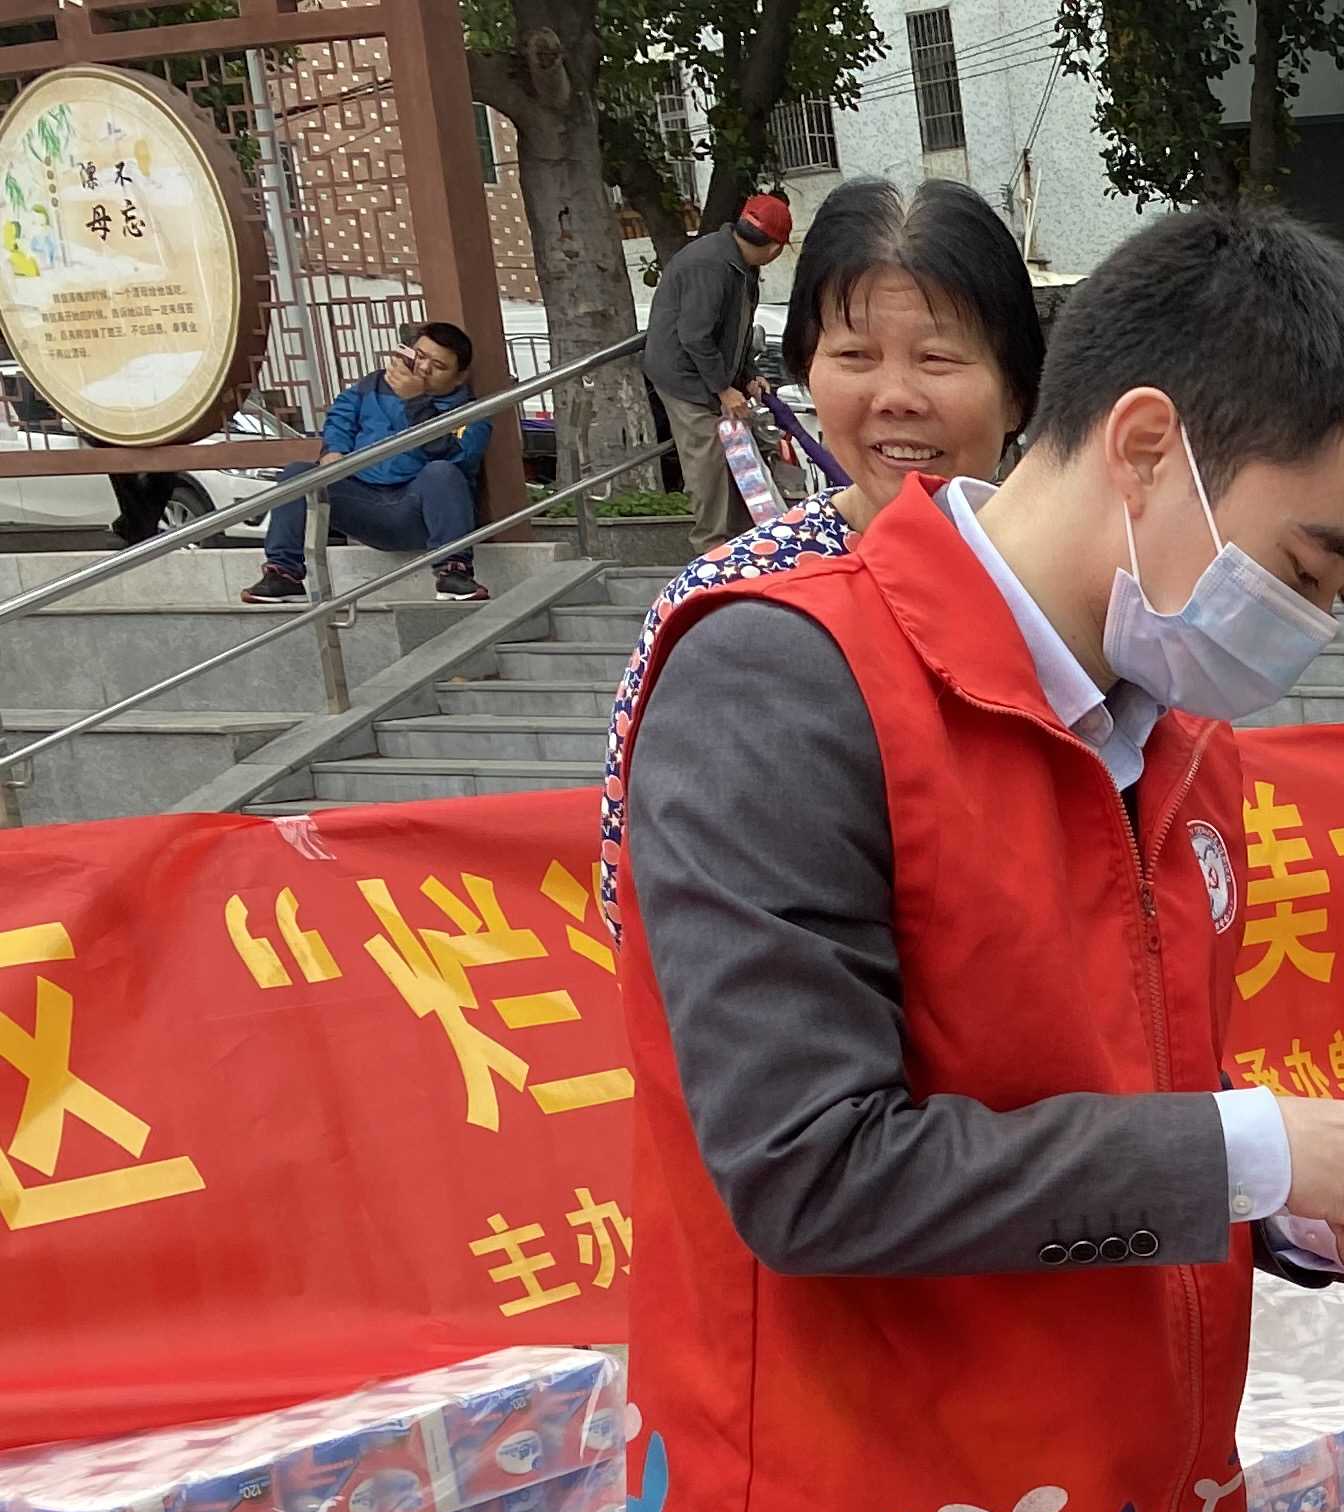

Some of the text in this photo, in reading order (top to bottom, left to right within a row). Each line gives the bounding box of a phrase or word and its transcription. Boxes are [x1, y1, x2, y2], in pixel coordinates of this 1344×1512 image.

[0, 921, 206, 1232] 区
[224, 858, 637, 1134] “烂
[468, 1186, 633, 1318] 主办
